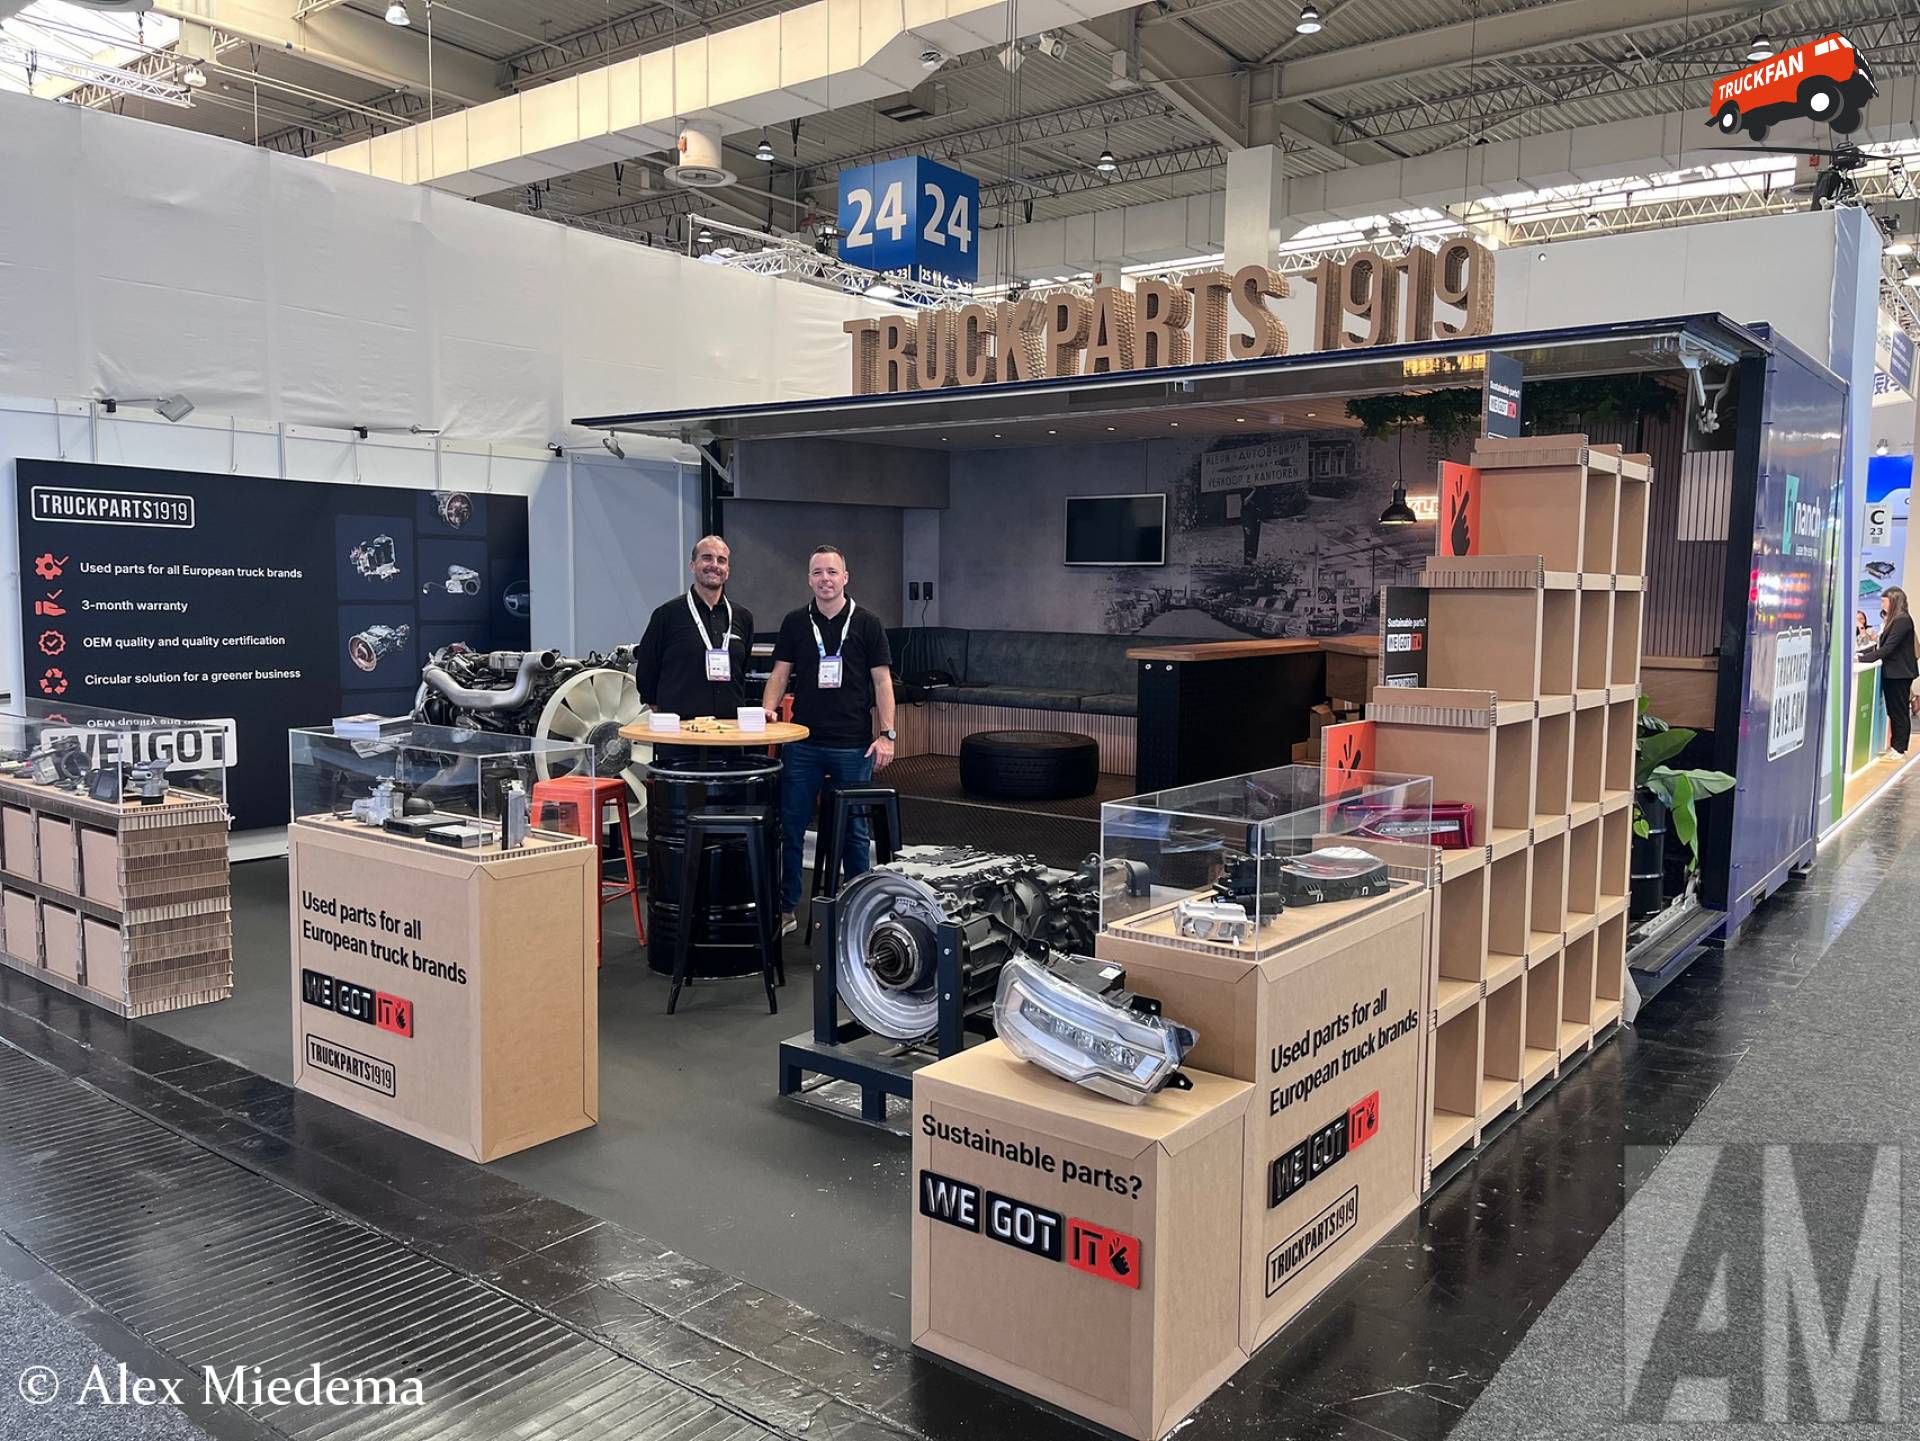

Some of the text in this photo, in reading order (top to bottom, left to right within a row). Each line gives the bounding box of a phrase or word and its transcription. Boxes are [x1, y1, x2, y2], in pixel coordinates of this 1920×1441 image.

[847, 182, 907, 248] 24
[924, 183, 971, 253] 24
[843, 238, 1496, 394] TRUCKPARTS 1919
[40, 494, 188, 521] TRUCKPARTS1919
[1870, 510, 1885, 525] C
[1870, 527, 1883, 536] 23
[80, 562, 303, 579] Used parts for all European truck brands
[81, 599, 188, 613] 3-month warranty
[83, 635, 286, 650] OEM quality and quality certification
[84, 669, 301, 685] Circular solution for a greener business
[302, 890, 421, 940] Used parts for all
[303, 920, 467, 985] European truck brands
[304, 973, 392, 1025] WE GOT IT
[1271, 988, 1387, 1074] Used parts for all
[310, 1041, 392, 1089] TRUCKPARTS1919
[1269, 1008, 1418, 1117] European truck brands
[922, 1114, 1143, 1200] Sustainable parts?
[1275, 1106, 1365, 1199] WE GOT IT
[925, 1177, 1103, 1266] WE GOT IT
[1271, 1196, 1356, 1284] TRUCKPARTS1919
